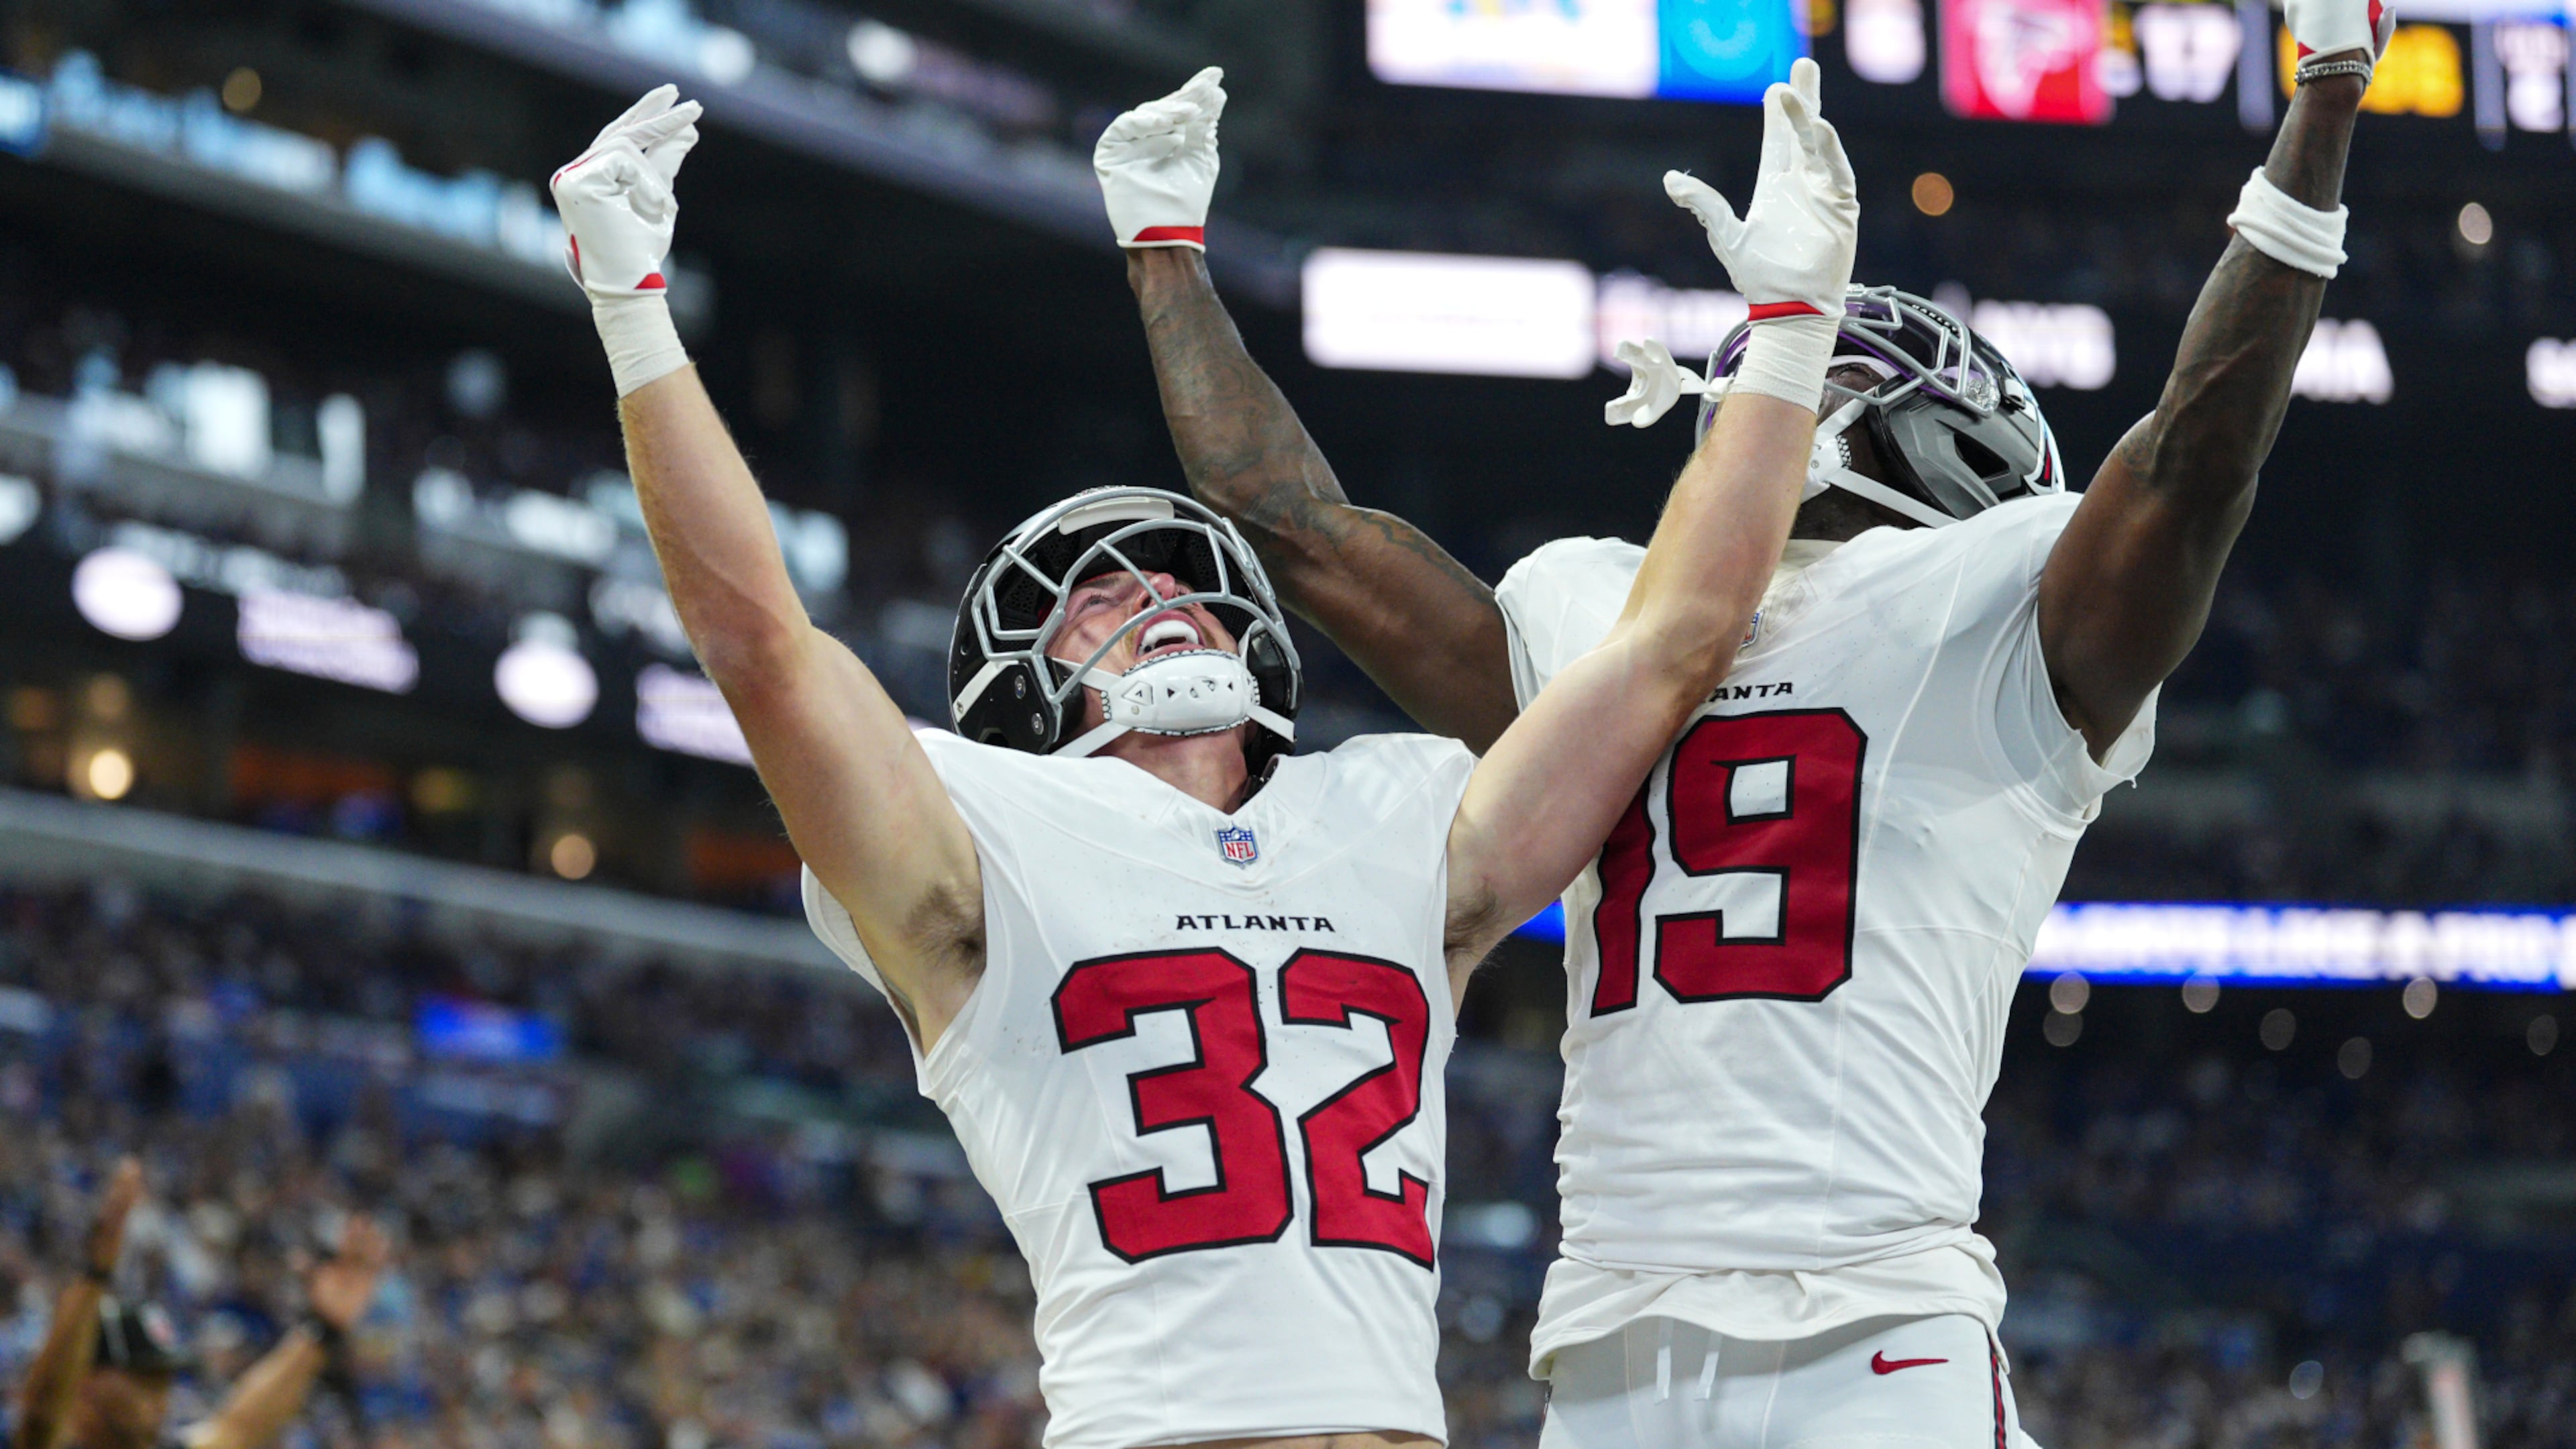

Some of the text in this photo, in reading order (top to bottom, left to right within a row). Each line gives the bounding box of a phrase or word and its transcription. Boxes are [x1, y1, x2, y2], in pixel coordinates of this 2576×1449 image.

[1708, 682, 1793, 702] ANTA
[1225, 842, 1254, 859] NFL
[1176, 914, 1336, 933] ATLANTA
[1051, 947, 1435, 1272] 32
